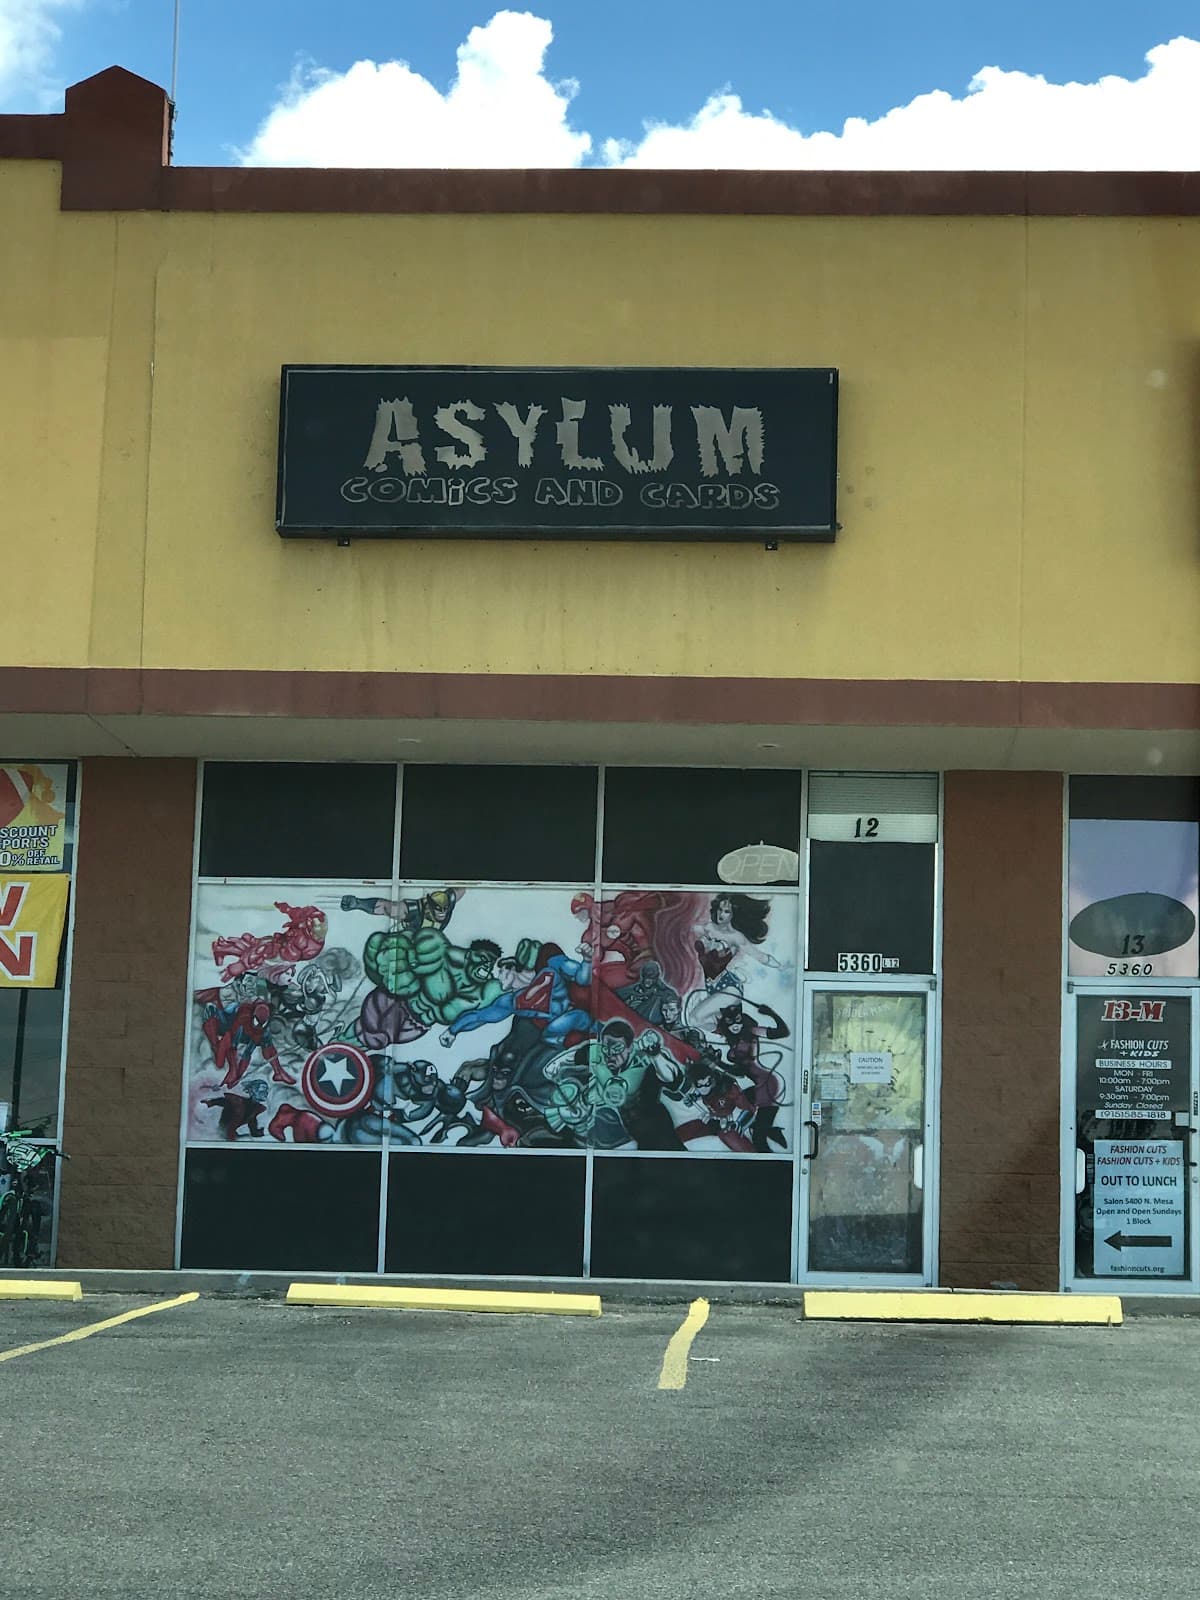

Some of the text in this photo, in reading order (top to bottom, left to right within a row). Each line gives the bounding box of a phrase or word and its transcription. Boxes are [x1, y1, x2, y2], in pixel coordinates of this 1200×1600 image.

[363, 396, 766, 477] ASYLUM
[535, 478, 624, 506] AND
[639, 482, 781, 510] CARDS
[854, 817, 880, 838] 12
[0, 837, 50, 850] PORTS
[27, 850, 45, 858] OFF
[26, 856, 60, 865] RETAIL
[720, 853, 797, 878] OPEN
[1121, 934, 1146, 955] 13
[839, 954, 881, 972] 5360
[1106, 963, 1153, 976] 5360
[1101, 1000, 1166, 1022] 13-M
[1110, 1039, 1169, 1050] FASHION CUTS
[1098, 1060, 1168, 1069] BUSINESS HOURS
[1104, 1101, 1133, 1109] Sunday
[1110, 1145, 1168, 1154] FASHION CUTS
[1097, 1156, 1131, 1165] FASHION
[1133, 1156, 1153, 1165] CUTS
[1162, 1156, 1181, 1165] KIDS
[1101, 1175, 1177, 1186] OUT TO LUNCH
[1096, 1208, 1115, 1216] Open
[1131, 1208, 1150, 1216] Open
[1152, 1208, 1182, 1216] Sundays
